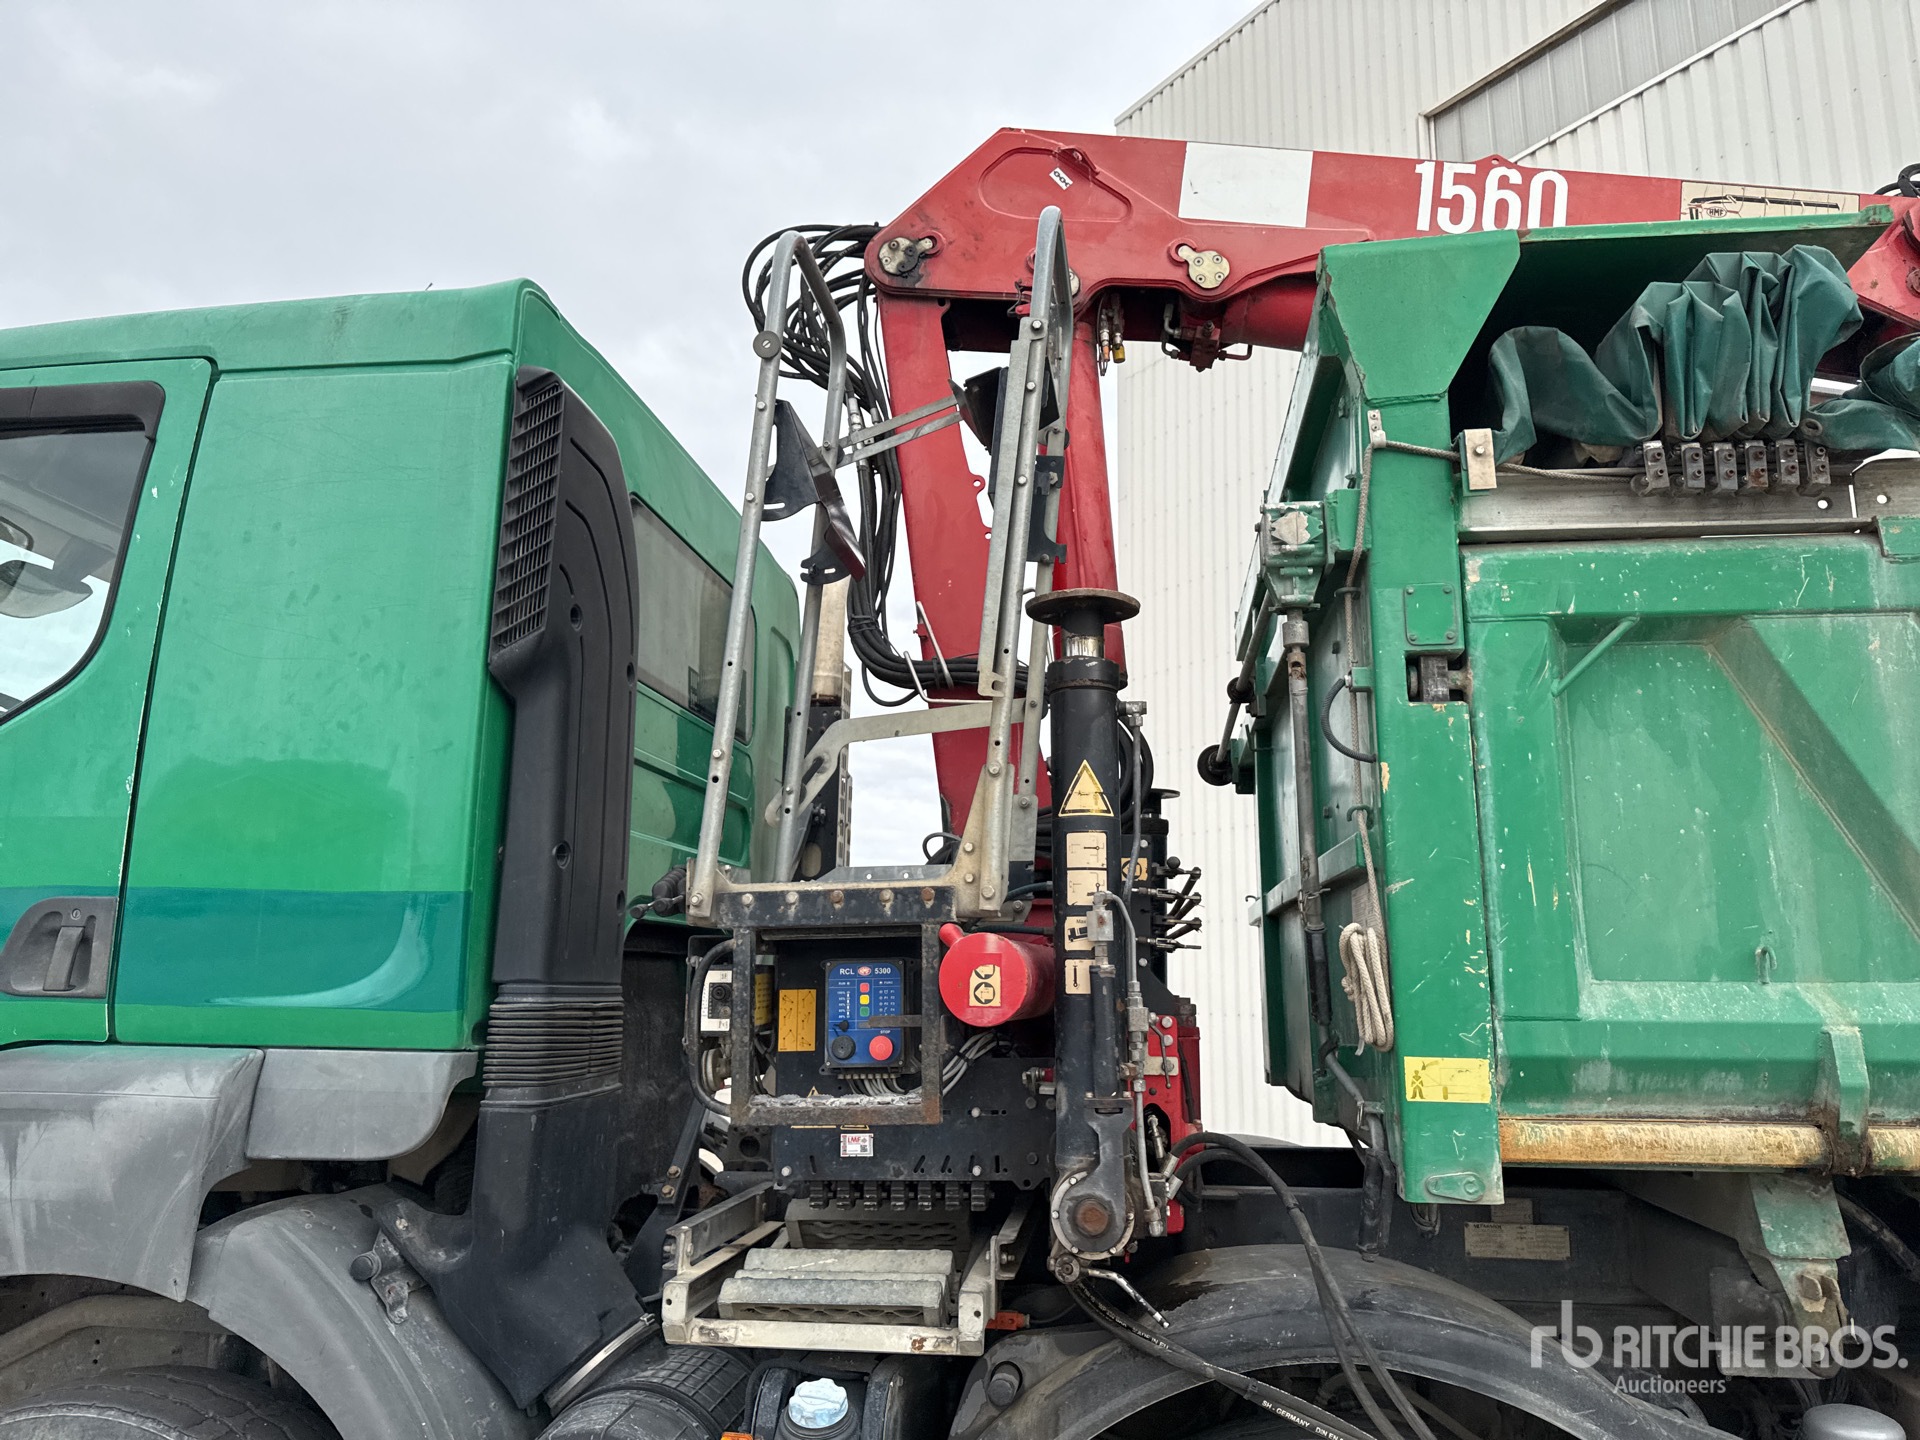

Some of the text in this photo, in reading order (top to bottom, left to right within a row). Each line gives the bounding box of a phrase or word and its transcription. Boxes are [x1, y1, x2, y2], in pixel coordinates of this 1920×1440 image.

[1415, 161, 1568, 234] 1560
[1262, 1400, 1272, 1408] SH
[1276, 1408, 1310, 1427] GERMANY
[1315, 1426, 1328, 1437] DIN
